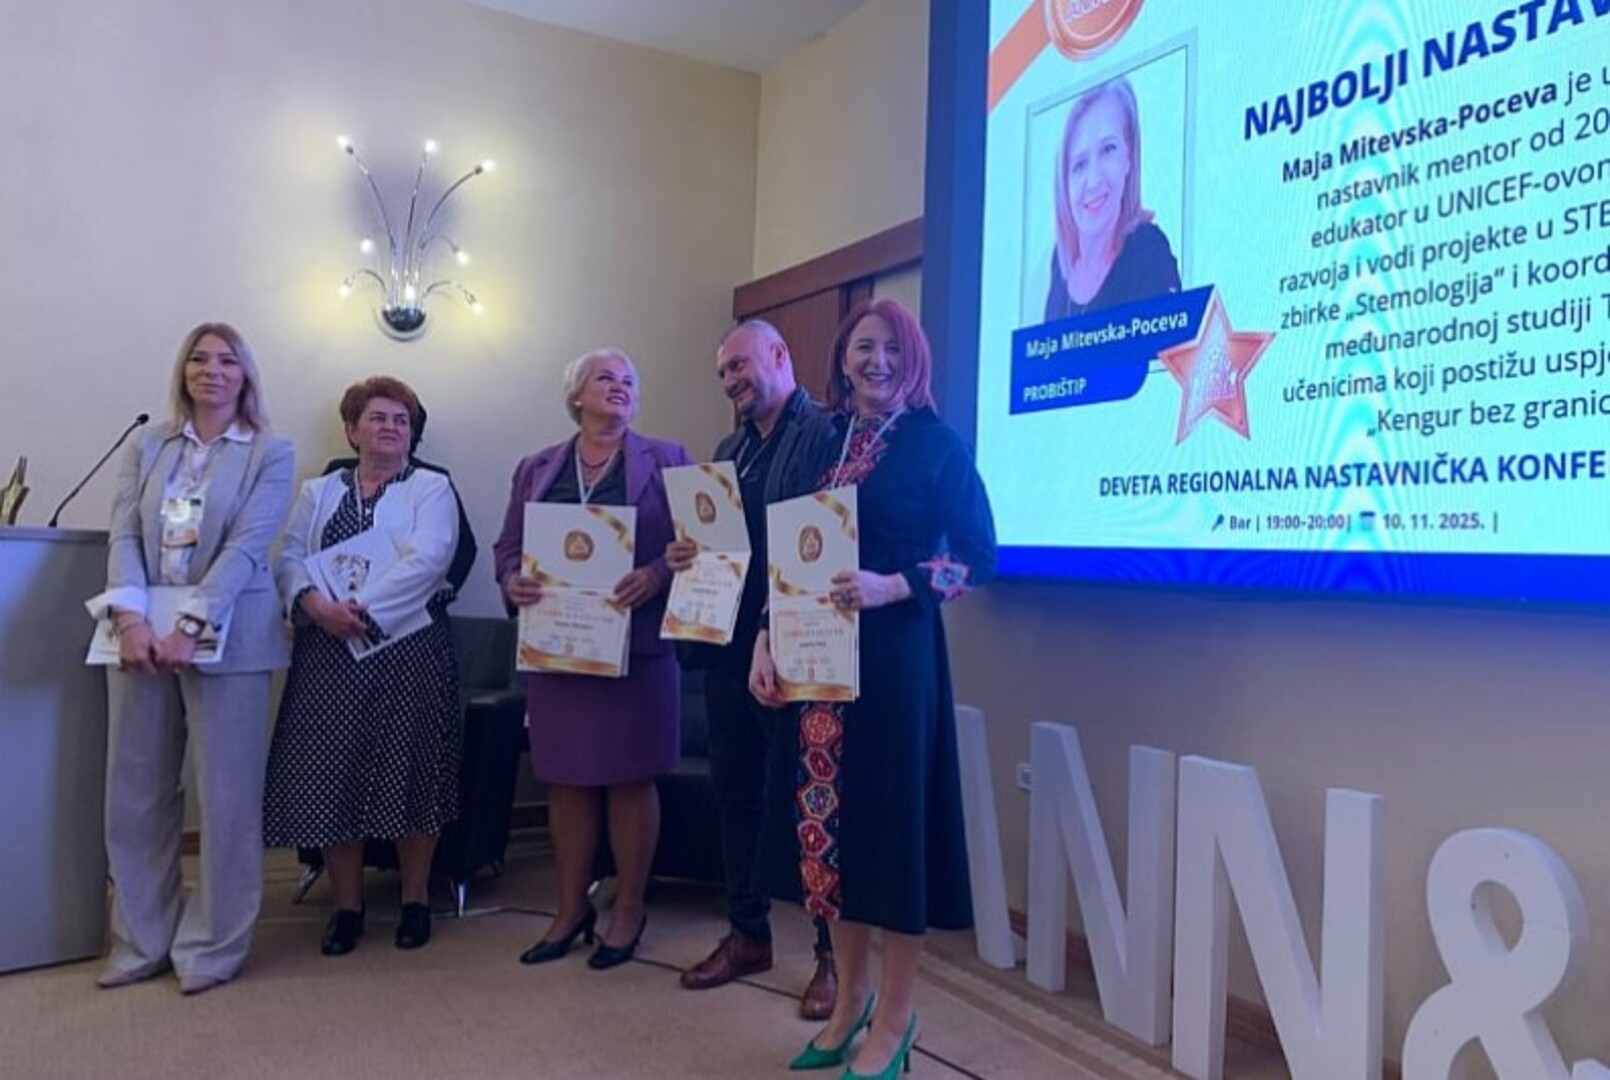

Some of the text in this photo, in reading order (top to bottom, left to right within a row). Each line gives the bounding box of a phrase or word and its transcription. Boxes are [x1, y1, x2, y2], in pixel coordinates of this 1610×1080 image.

[1244, 49, 1408, 141] NAJBOLJI
[1282, 151, 1333, 183] Maja
[1339, 82, 1557, 166] Mitevska-Poceva
[1564, 71, 1592, 106] je
[1317, 163, 1420, 211] nastavnik
[1427, 137, 1522, 181] mentor
[1530, 117, 1564, 152] od
[1279, 261, 1349, 294] razvoja
[1367, 244, 1414, 275] vodi
[1422, 225, 1528, 271] projekte
[1536, 219, 1553, 240] u
[1563, 200, 1610, 235] STE
[1311, 209, 1408, 249] edukator
[1414, 205, 1429, 224] u
[1281, 301, 1340, 329] zbirke
[1513, 263, 1518, 288] i
[1528, 244, 1610, 286] koord
[1026, 311, 1188, 360] Maja Mitevska-Poceva
[1326, 311, 1498, 360] međunarodnoj
[1507, 296, 1591, 333] studiji
[1023, 377, 1087, 403] PROBIŠTIP
[1283, 341, 1610, 402] učenicima koji postižu uspj
[1470, 400, 1516, 426] bez
[1100, 450, 1606, 497] DEVETA REGIONALNA NASTAVNIČKA KONFE
[1229, 515, 1251, 530] Bar
[1438, 513, 1485, 530] 2025.
